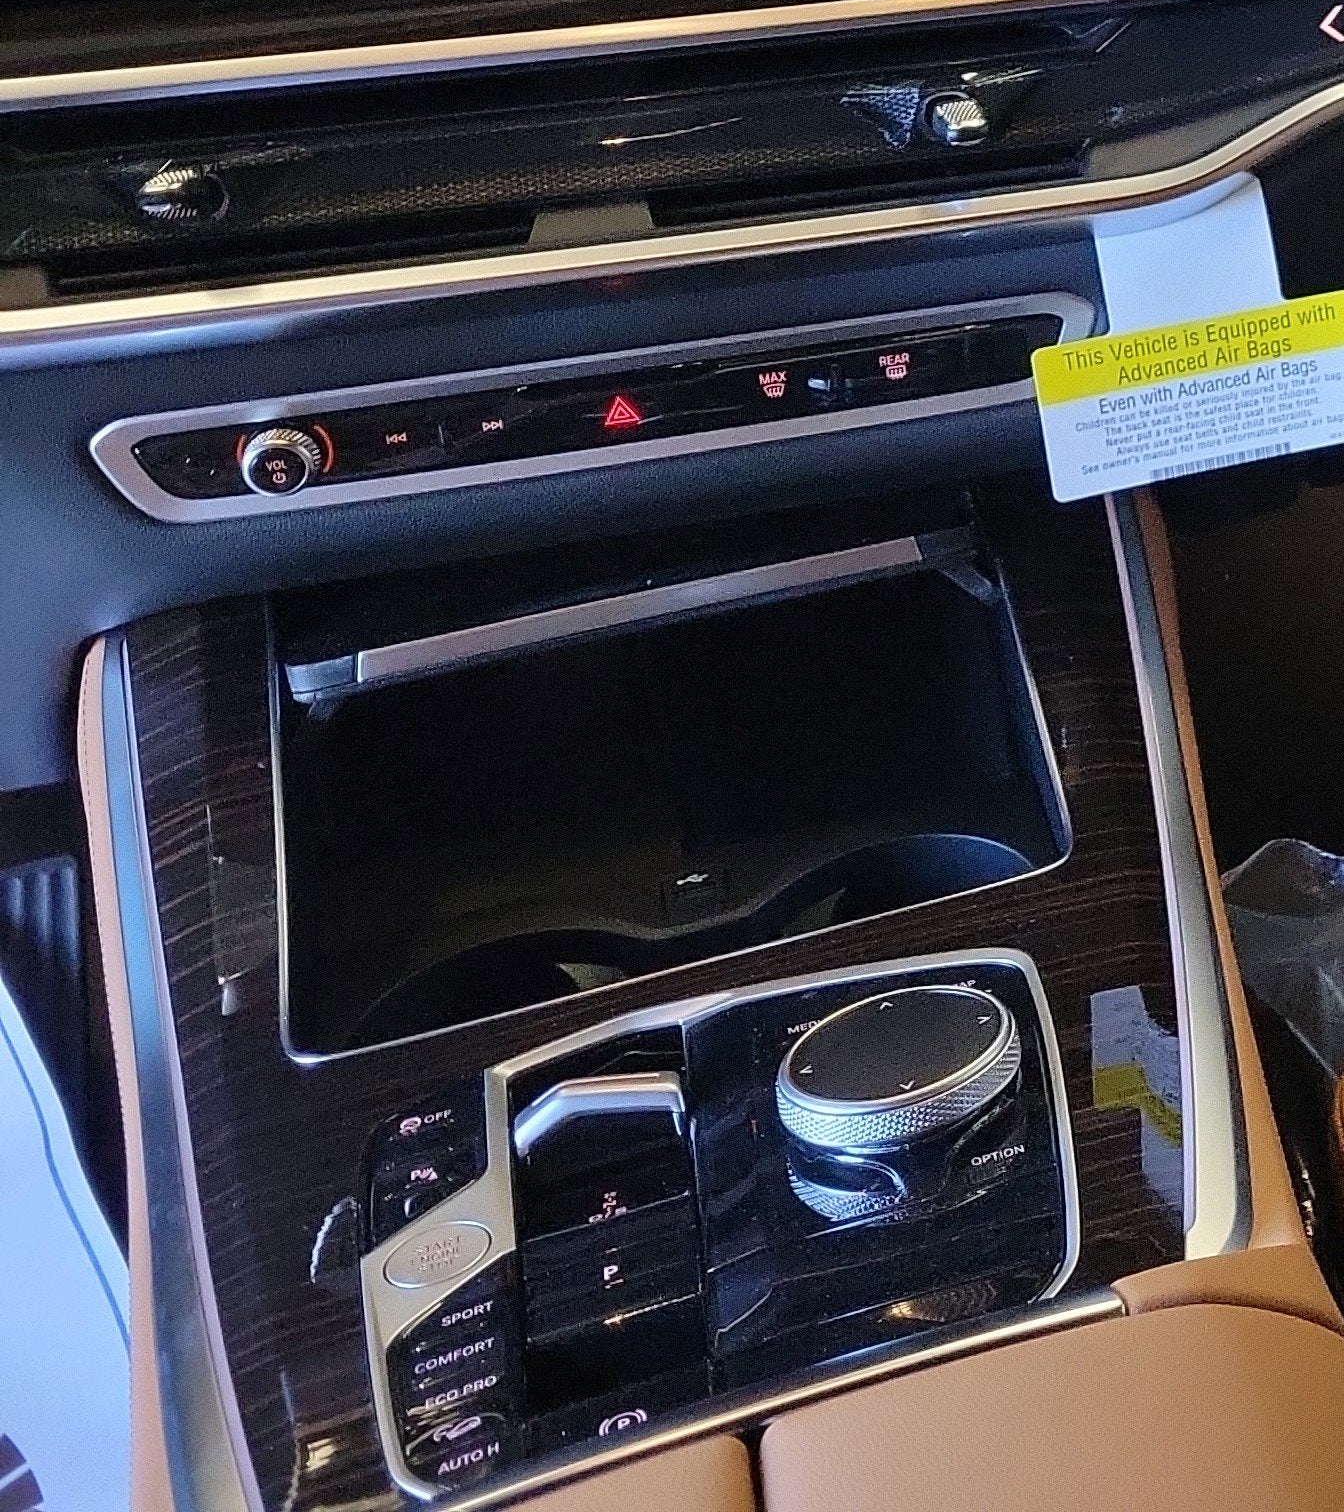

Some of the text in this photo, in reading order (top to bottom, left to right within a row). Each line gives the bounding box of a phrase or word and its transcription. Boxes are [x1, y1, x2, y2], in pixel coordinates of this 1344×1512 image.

[1063, 303, 1336, 371] This Vehicle is Equipped with
[878, 352, 910, 368] REAR
[1118, 337, 1292, 386] Advanced Air Bags
[758, 370, 788, 386] MAX
[1099, 360, 1318, 414] Even with Advanced Air Bags
[1075, 417, 1116, 432] Children
[1119, 412, 1136, 423] can
[1154, 403, 1179, 415] killed
[265, 460, 287, 472] VOL
[787, 1018, 823, 1035] MED
[424, 1109, 452, 1124] OFF
[970, 1144, 1025, 1167] OPTION
[603, 1265, 619, 1281] P
[440, 1300, 494, 1327] SPORT
[414, 1336, 496, 1375] COMFORT
[463, 1375, 498, 1396] PRO
[437, 1441, 500, 1476] AUTO H
